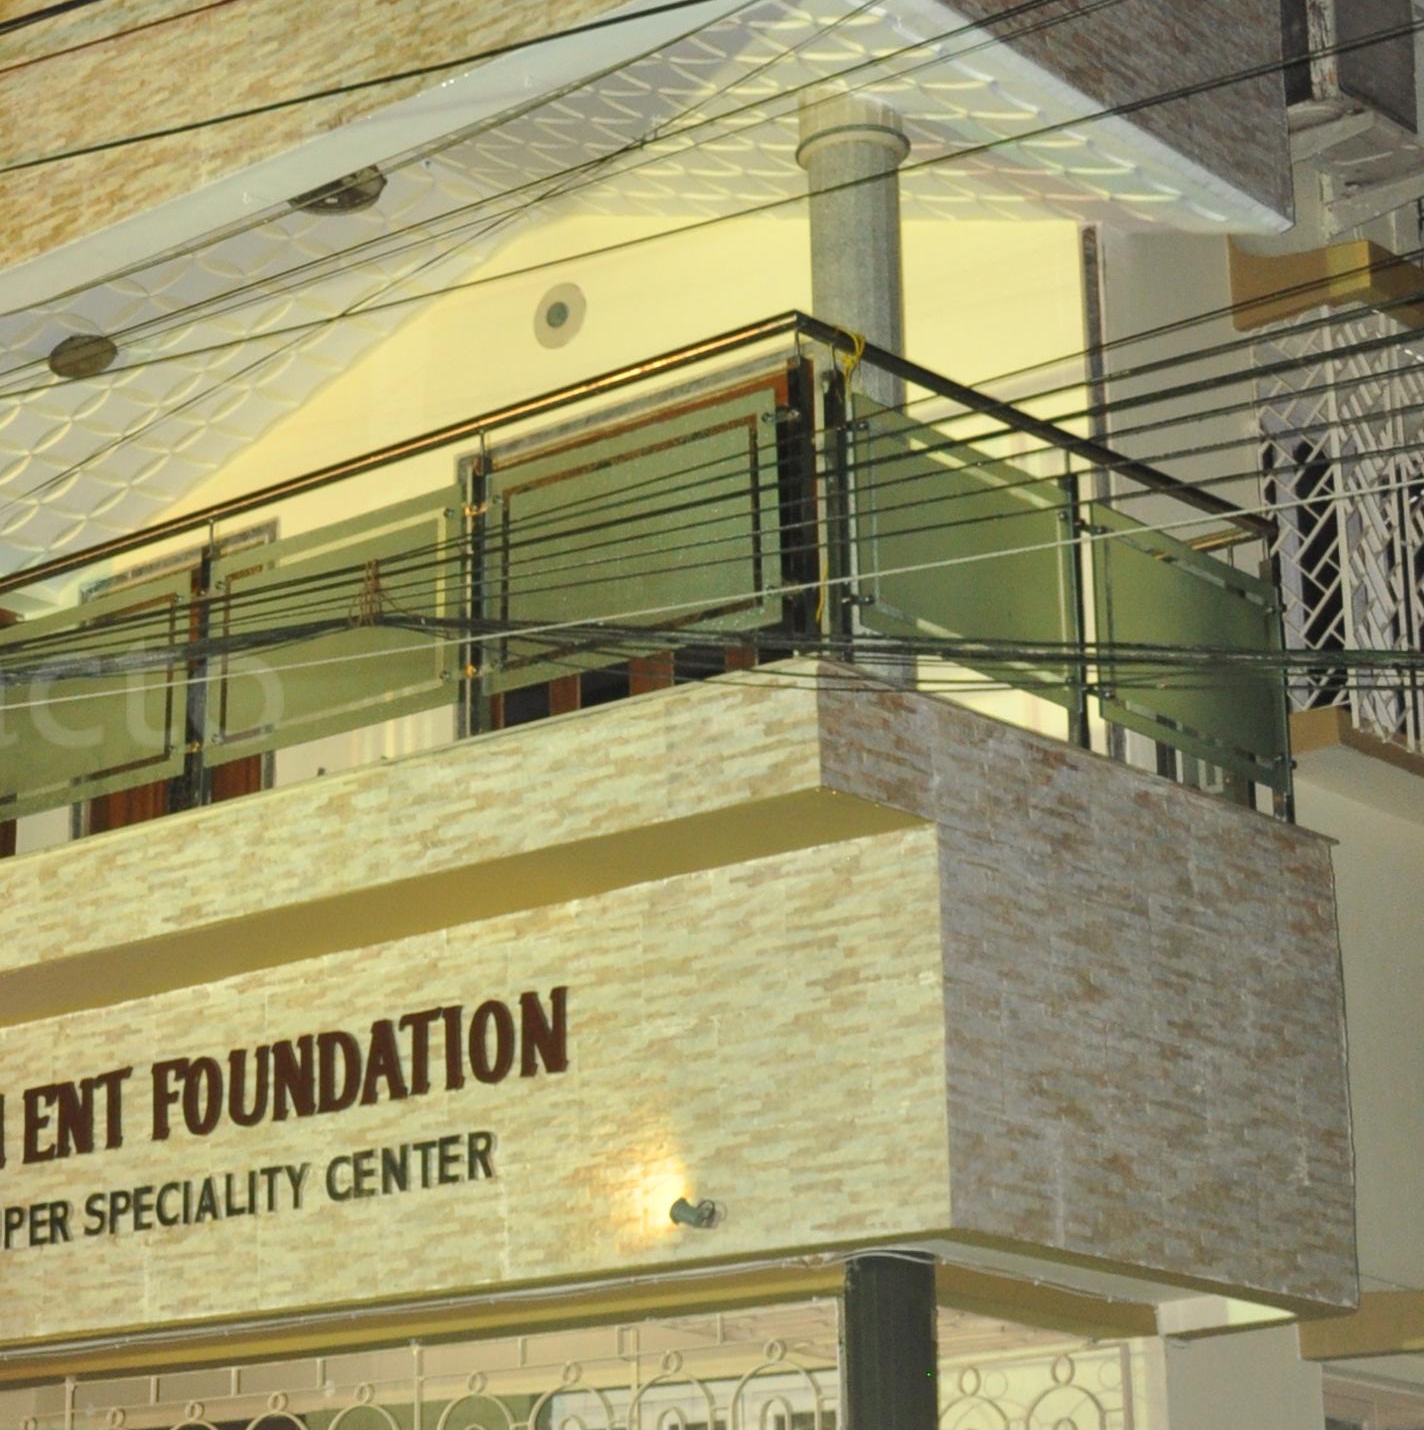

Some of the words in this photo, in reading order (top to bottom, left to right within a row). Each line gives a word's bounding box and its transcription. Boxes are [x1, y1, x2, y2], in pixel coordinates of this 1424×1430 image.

[22, 1066, 134, 1163] ENT
[151, 986, 570, 1140] FOUNDATION
[84, 1162, 313, 1237] SPECIALITY
[326, 1130, 497, 1203] CENTER
